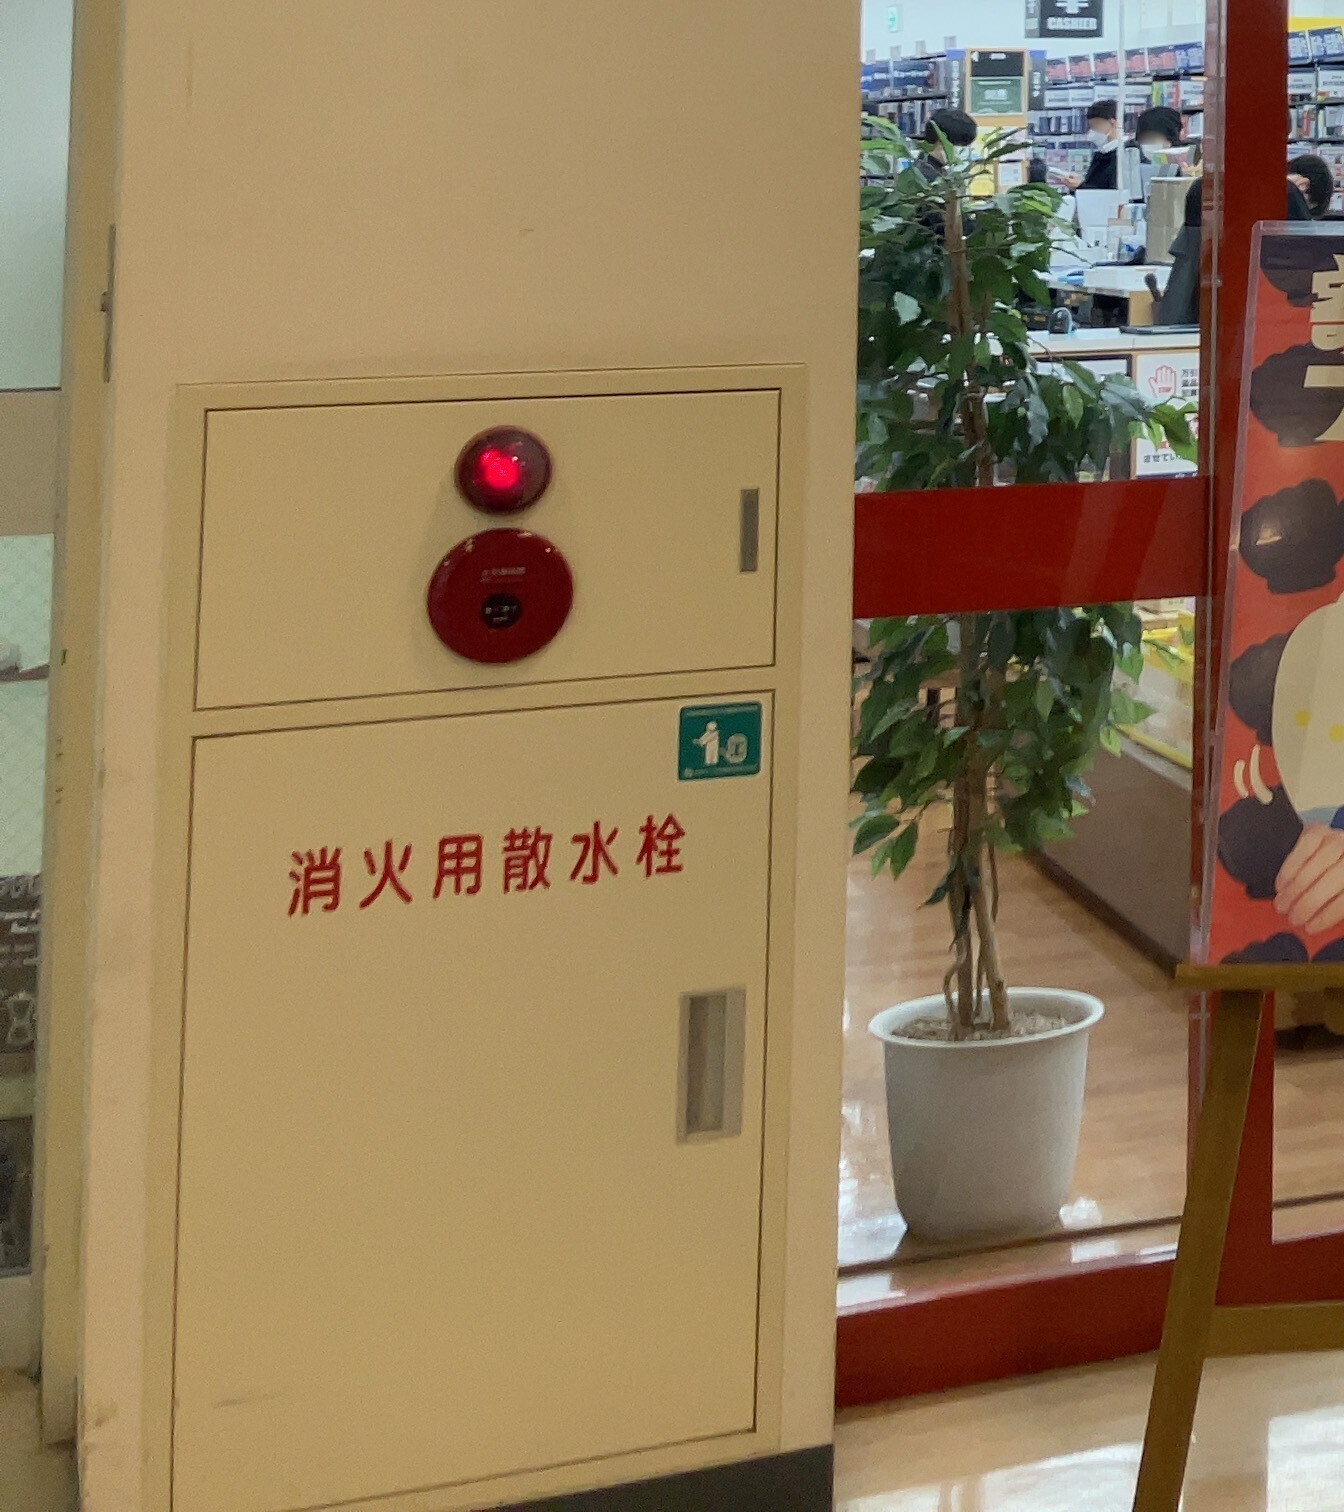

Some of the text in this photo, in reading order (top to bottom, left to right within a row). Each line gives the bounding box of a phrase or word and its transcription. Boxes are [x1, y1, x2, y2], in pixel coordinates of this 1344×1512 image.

[287, 813, 688, 918] 消火用散水栓
